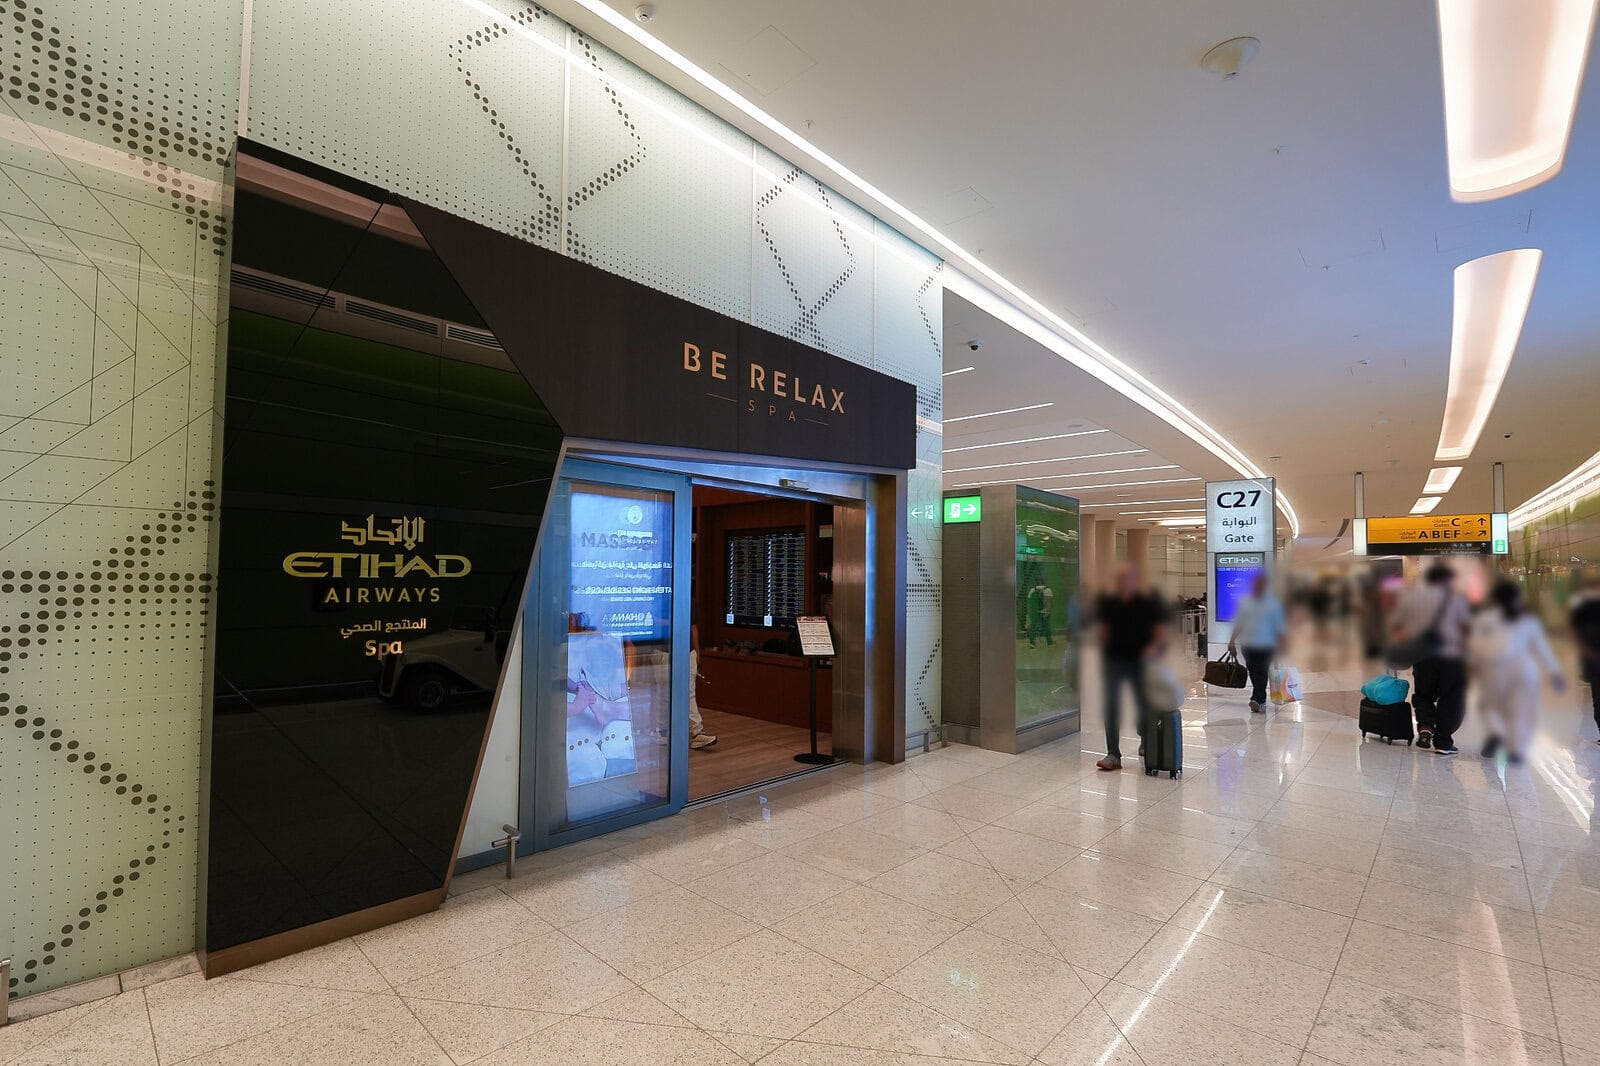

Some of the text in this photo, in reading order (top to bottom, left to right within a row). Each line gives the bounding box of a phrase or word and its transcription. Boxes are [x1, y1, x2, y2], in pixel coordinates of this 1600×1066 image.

[683, 342, 845, 414] BE RELAX
[748, 400, 797, 421] SPA
[1216, 490, 1261, 509] C27
[1222, 516, 1257, 529] البوابة
[1451, 518, 1460, 527] C
[1224, 533, 1255, 543] Gate
[282, 552, 472, 578] ETIHAD
[1219, 556, 1260, 565] ETIHAD
[324, 587, 441, 603] AIRWAYS
[340, 618, 427, 639] المنتجع الصحي
[365, 639, 403, 660] Spa
